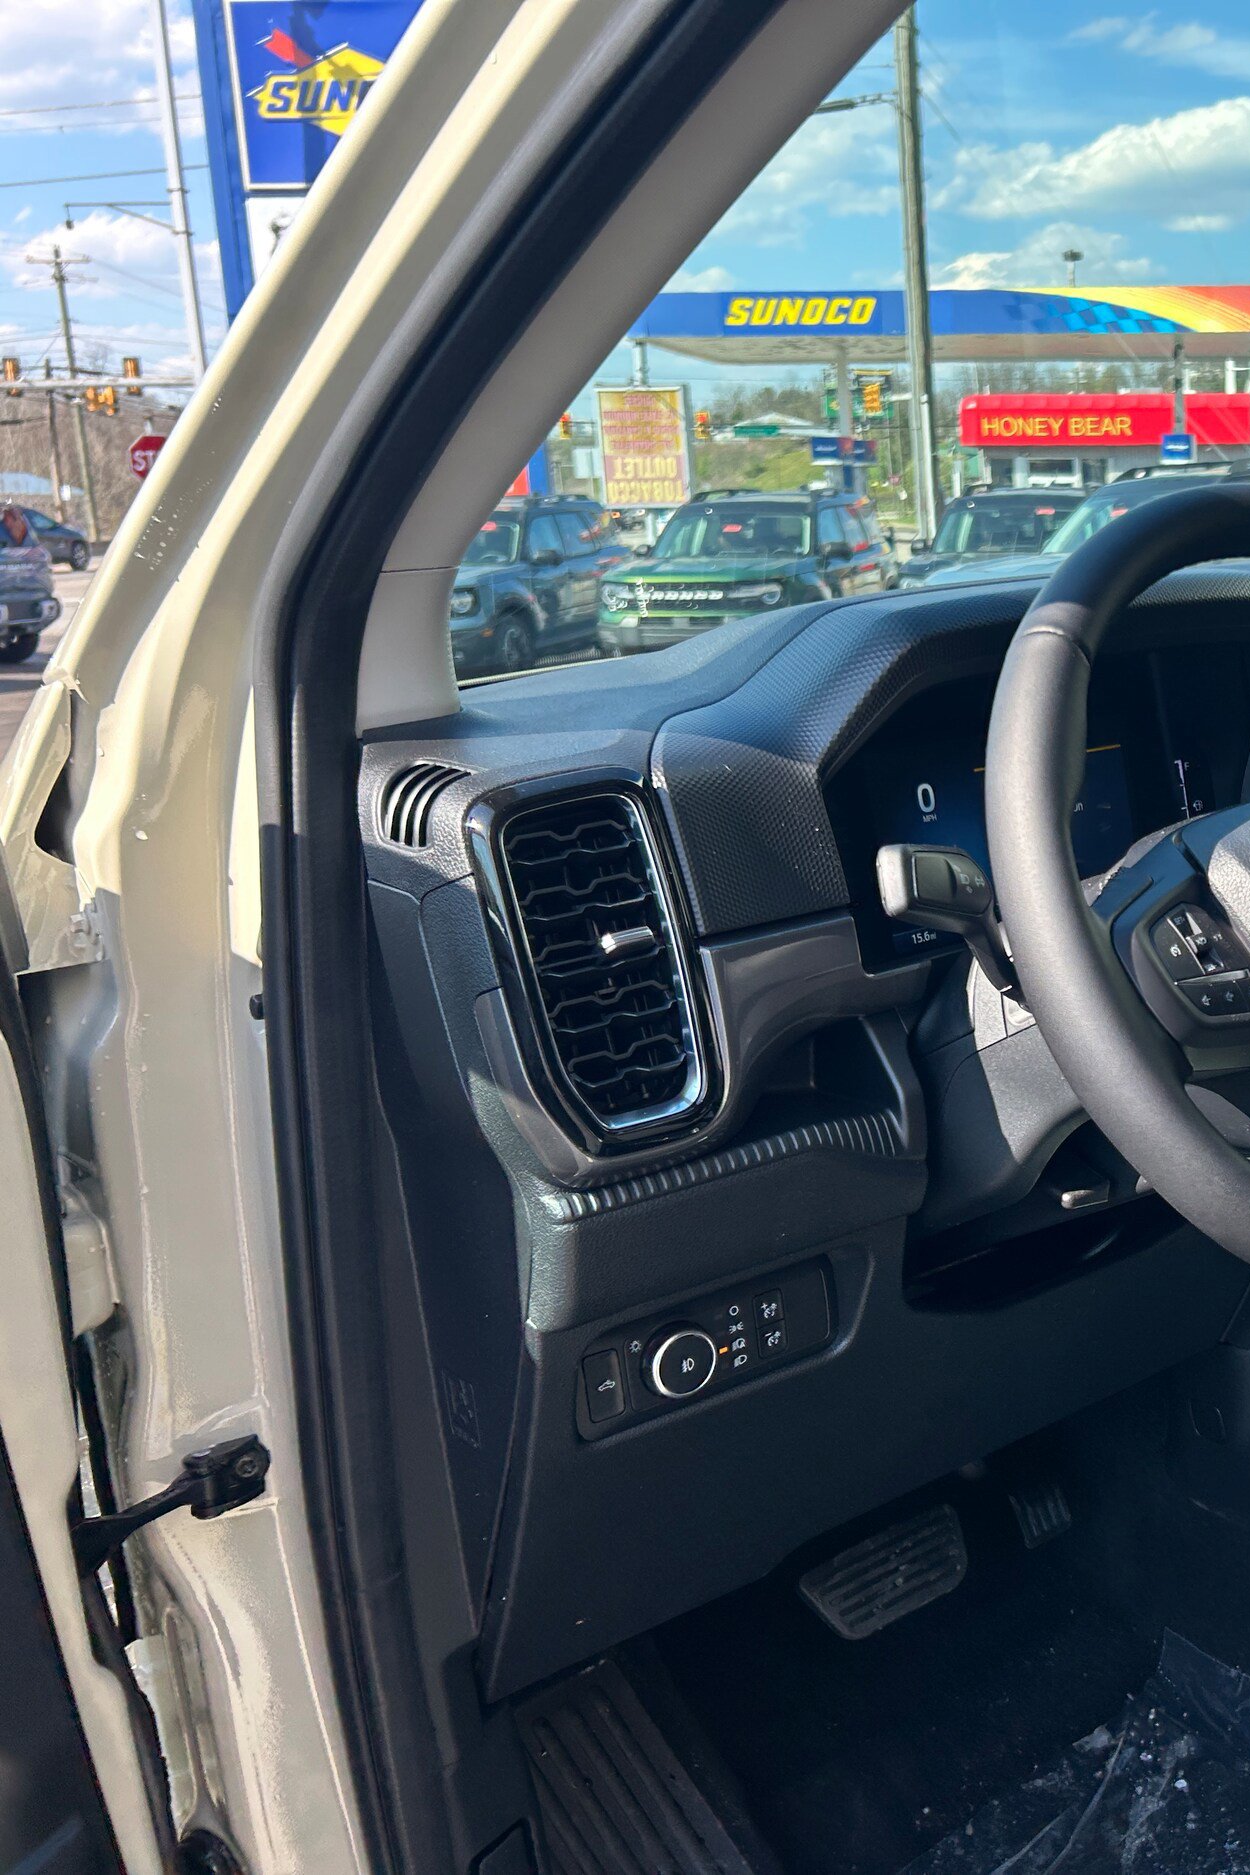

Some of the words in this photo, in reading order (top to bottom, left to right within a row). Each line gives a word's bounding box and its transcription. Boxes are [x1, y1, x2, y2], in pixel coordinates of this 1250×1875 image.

[266, 80, 375, 113] SUN
[725, 297, 877, 326] SUNOCO
[980, 416, 1065, 437] HONEY
[1069, 416, 1133, 437] BEAR
[613, 456, 678, 479] OUTLET
[606, 481, 685, 504] TOBACCO
[917, 782, 936, 813] 0
[922, 814, 938, 823] MPH
